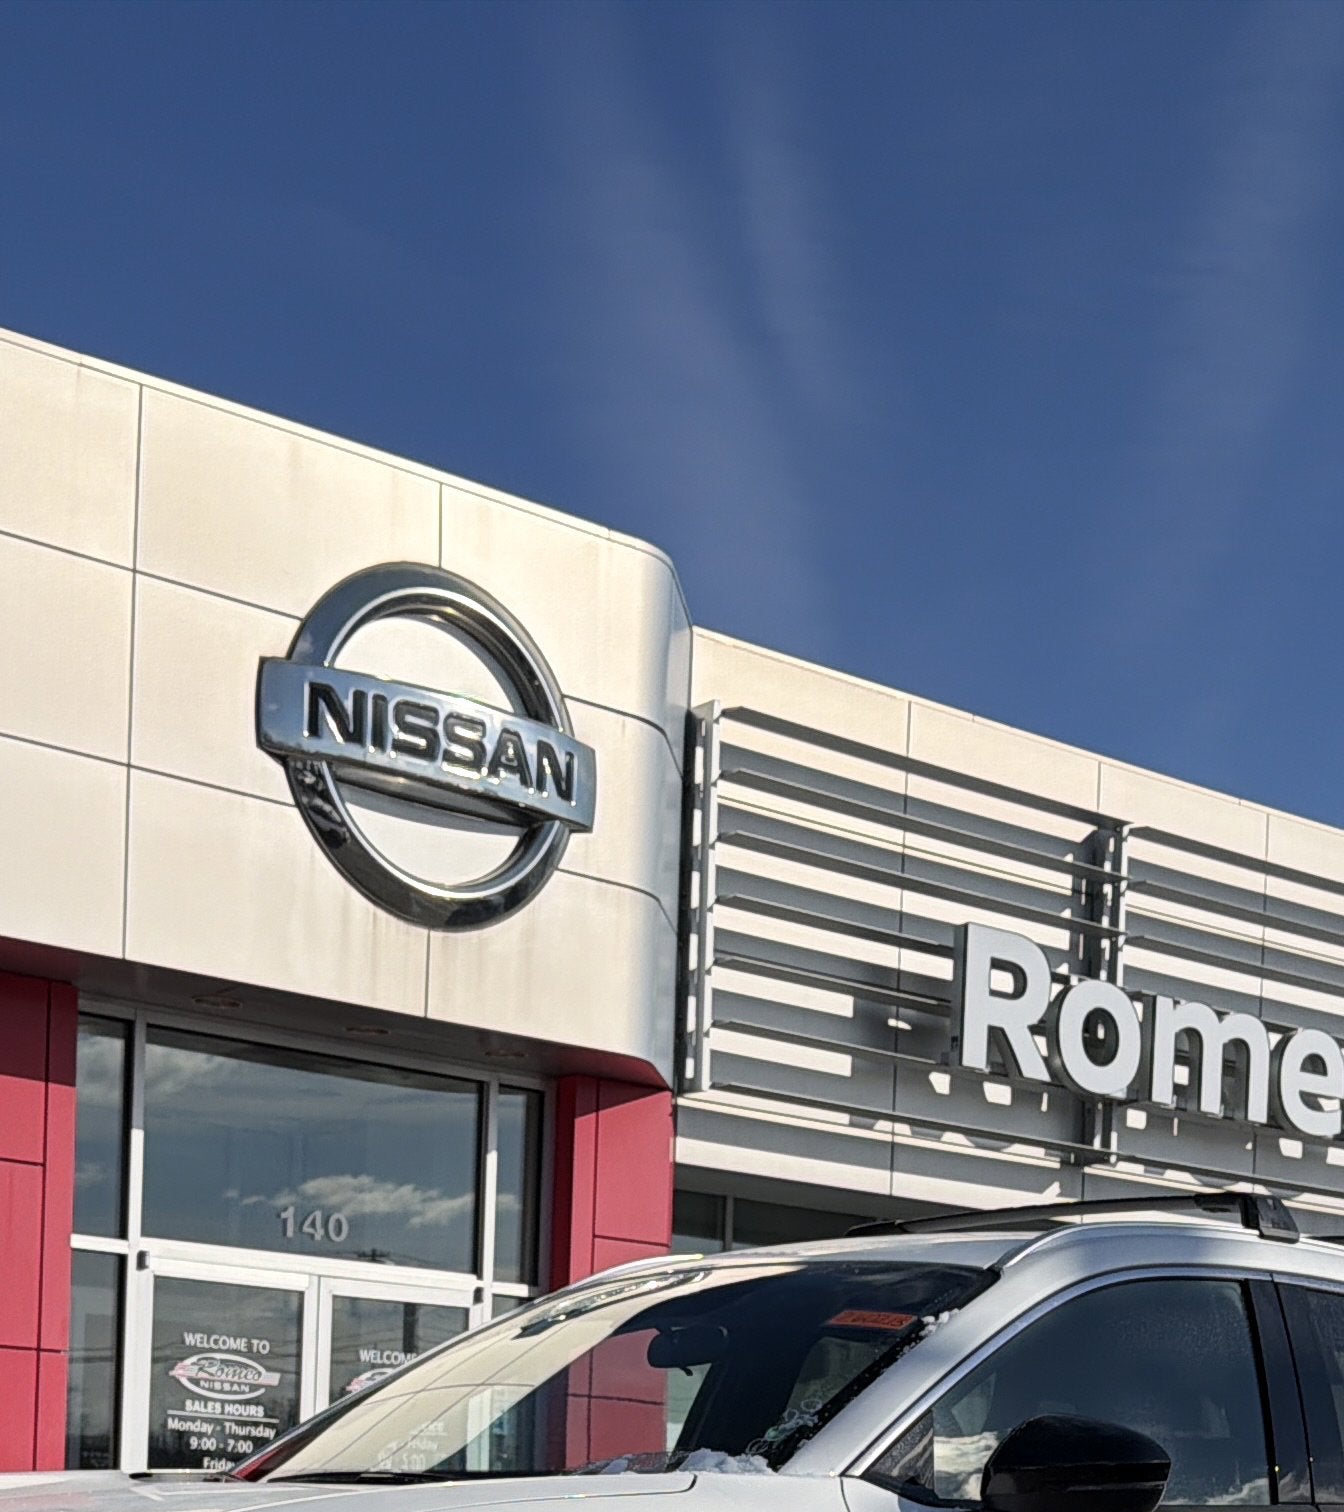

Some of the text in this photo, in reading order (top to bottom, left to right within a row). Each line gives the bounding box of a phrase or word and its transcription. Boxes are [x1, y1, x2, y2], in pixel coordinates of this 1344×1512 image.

[304, 680, 577, 806] NISSAN
[280, 1206, 348, 1242] 140
[183, 1331, 270, 1355] WELCOME TO
[199, 1380, 250, 1393] NISSAN
[185, 1399, 265, 1418] SALES HOURS
[167, 1417, 214, 1436] Monday
[224, 1421, 277, 1441] Thursday
[189, 1436, 217, 1451] 9:00
[227, 1439, 253, 1454] 7:00
